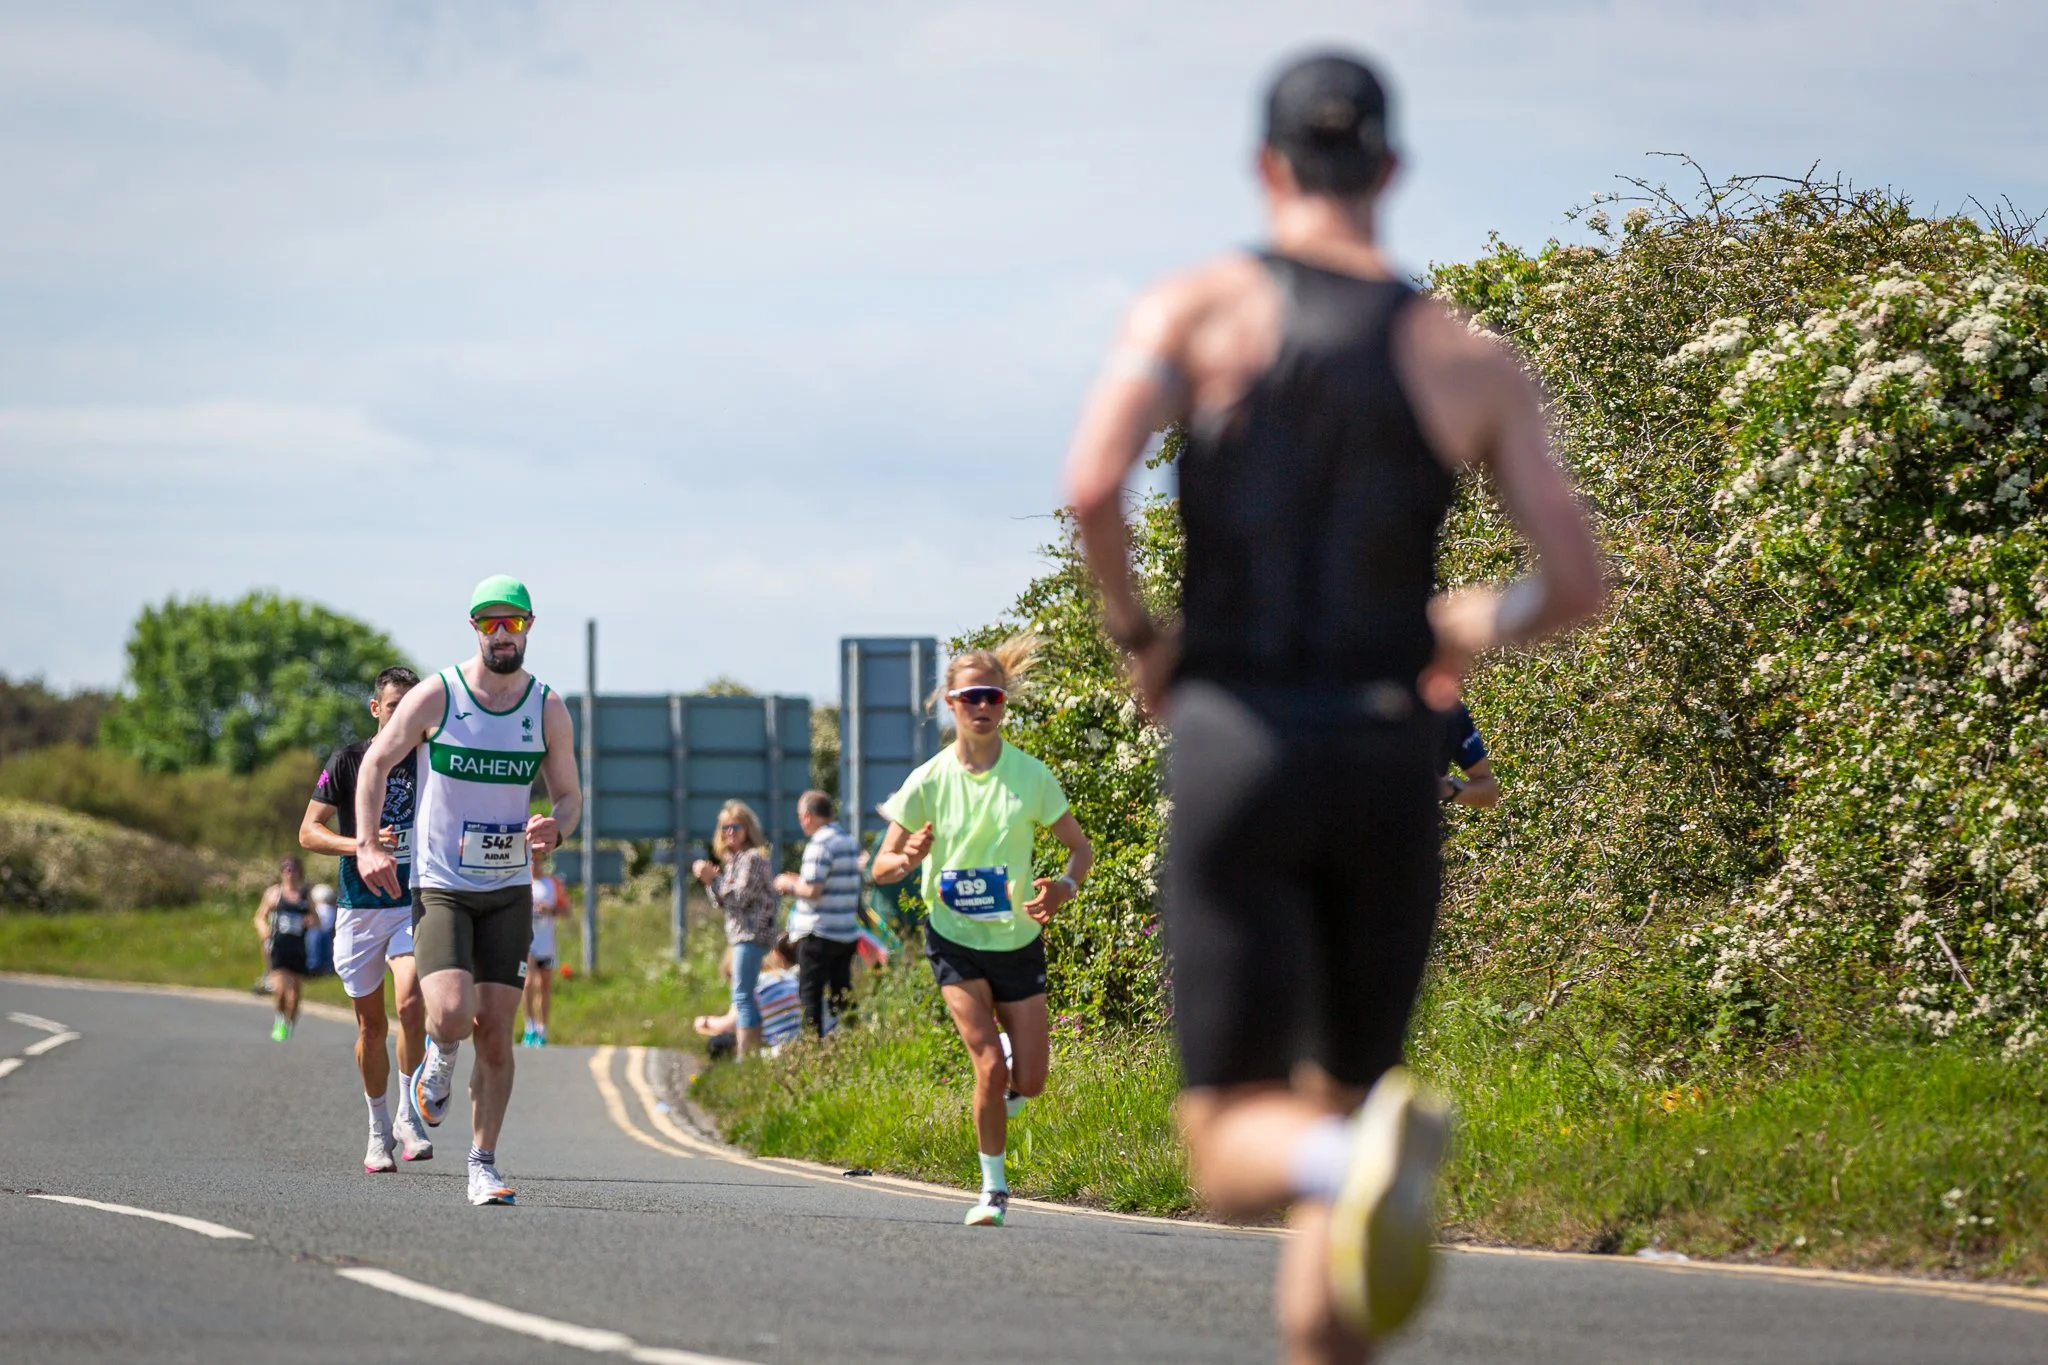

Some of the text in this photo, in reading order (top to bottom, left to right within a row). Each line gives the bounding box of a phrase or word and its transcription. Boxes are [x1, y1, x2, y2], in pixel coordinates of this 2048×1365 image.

[449, 754, 535, 777] RAHENY
[396, 808, 412, 822] CLUB
[481, 835, 513, 850] 542
[955, 878, 987, 896] 139
